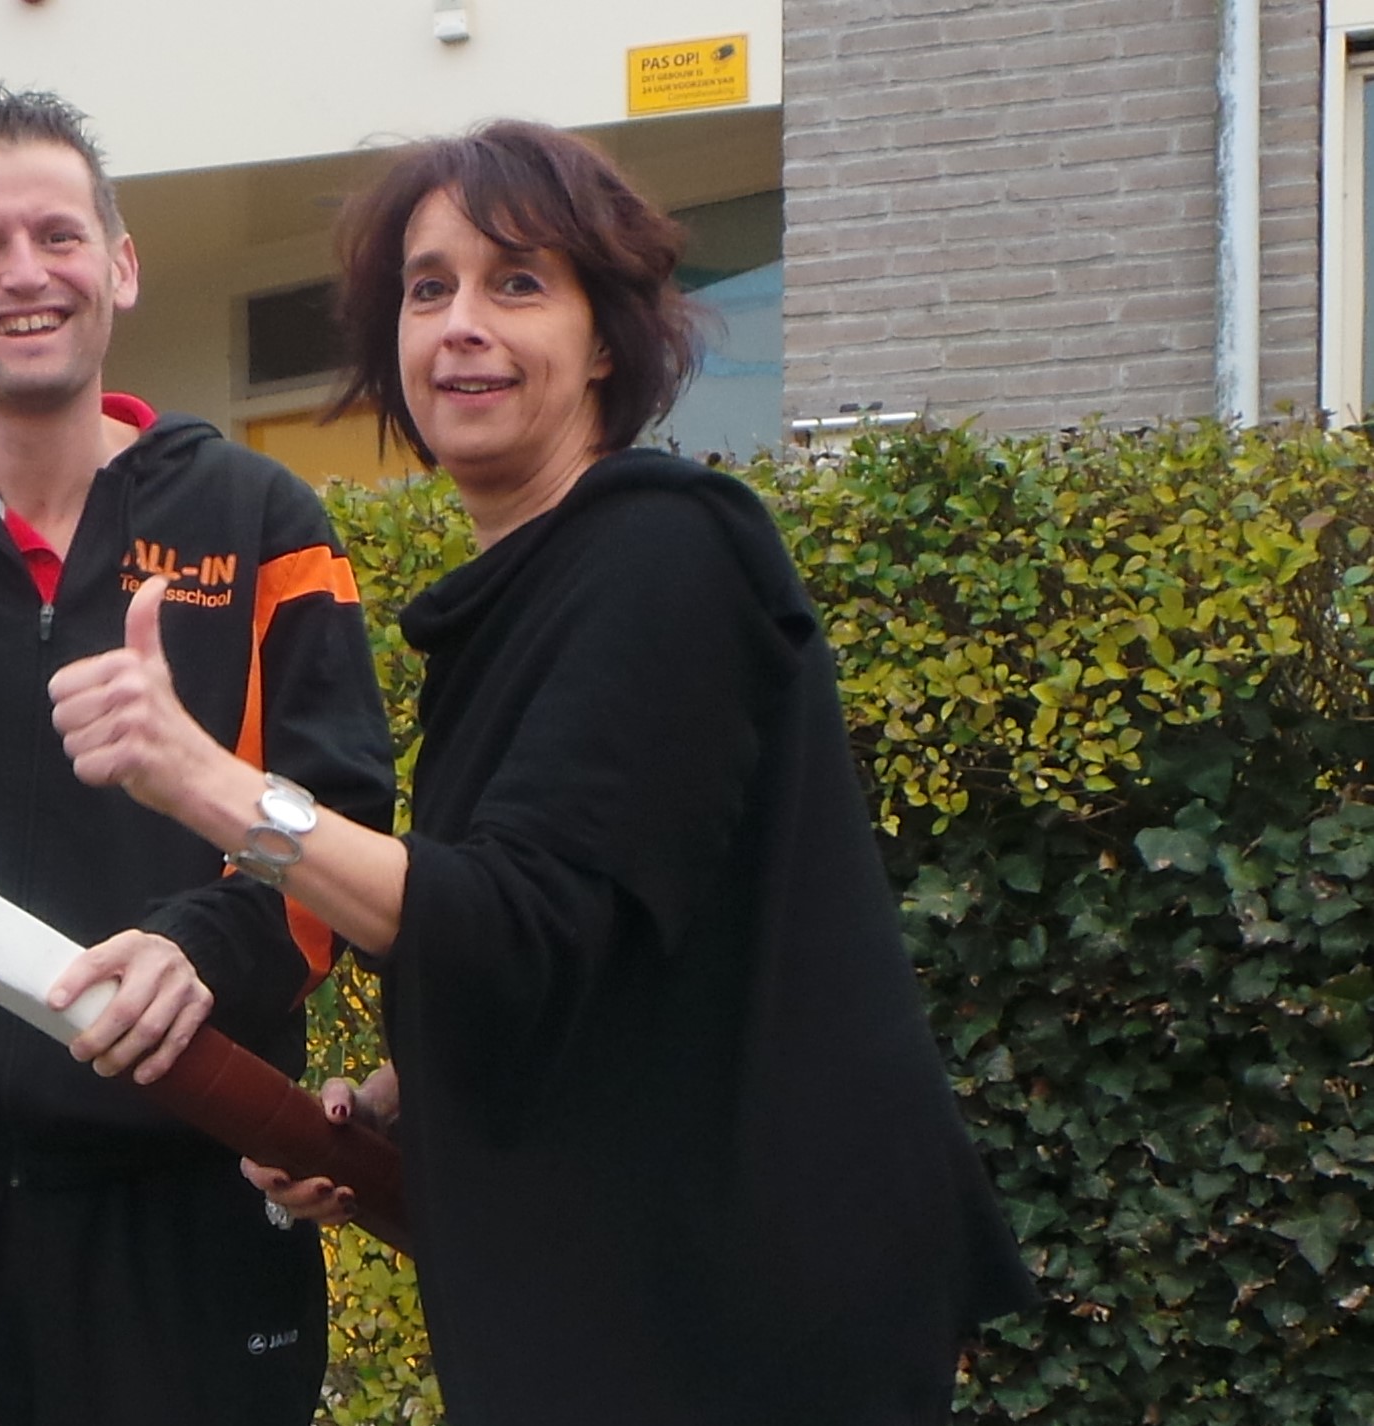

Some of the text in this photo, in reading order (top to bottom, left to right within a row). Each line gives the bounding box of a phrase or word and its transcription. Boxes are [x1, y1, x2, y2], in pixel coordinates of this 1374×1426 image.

[641, 52, 700, 71] PAS OP!
[122, 538, 237, 586] ALL-IN
[120, 573, 232, 608] Tesschool
